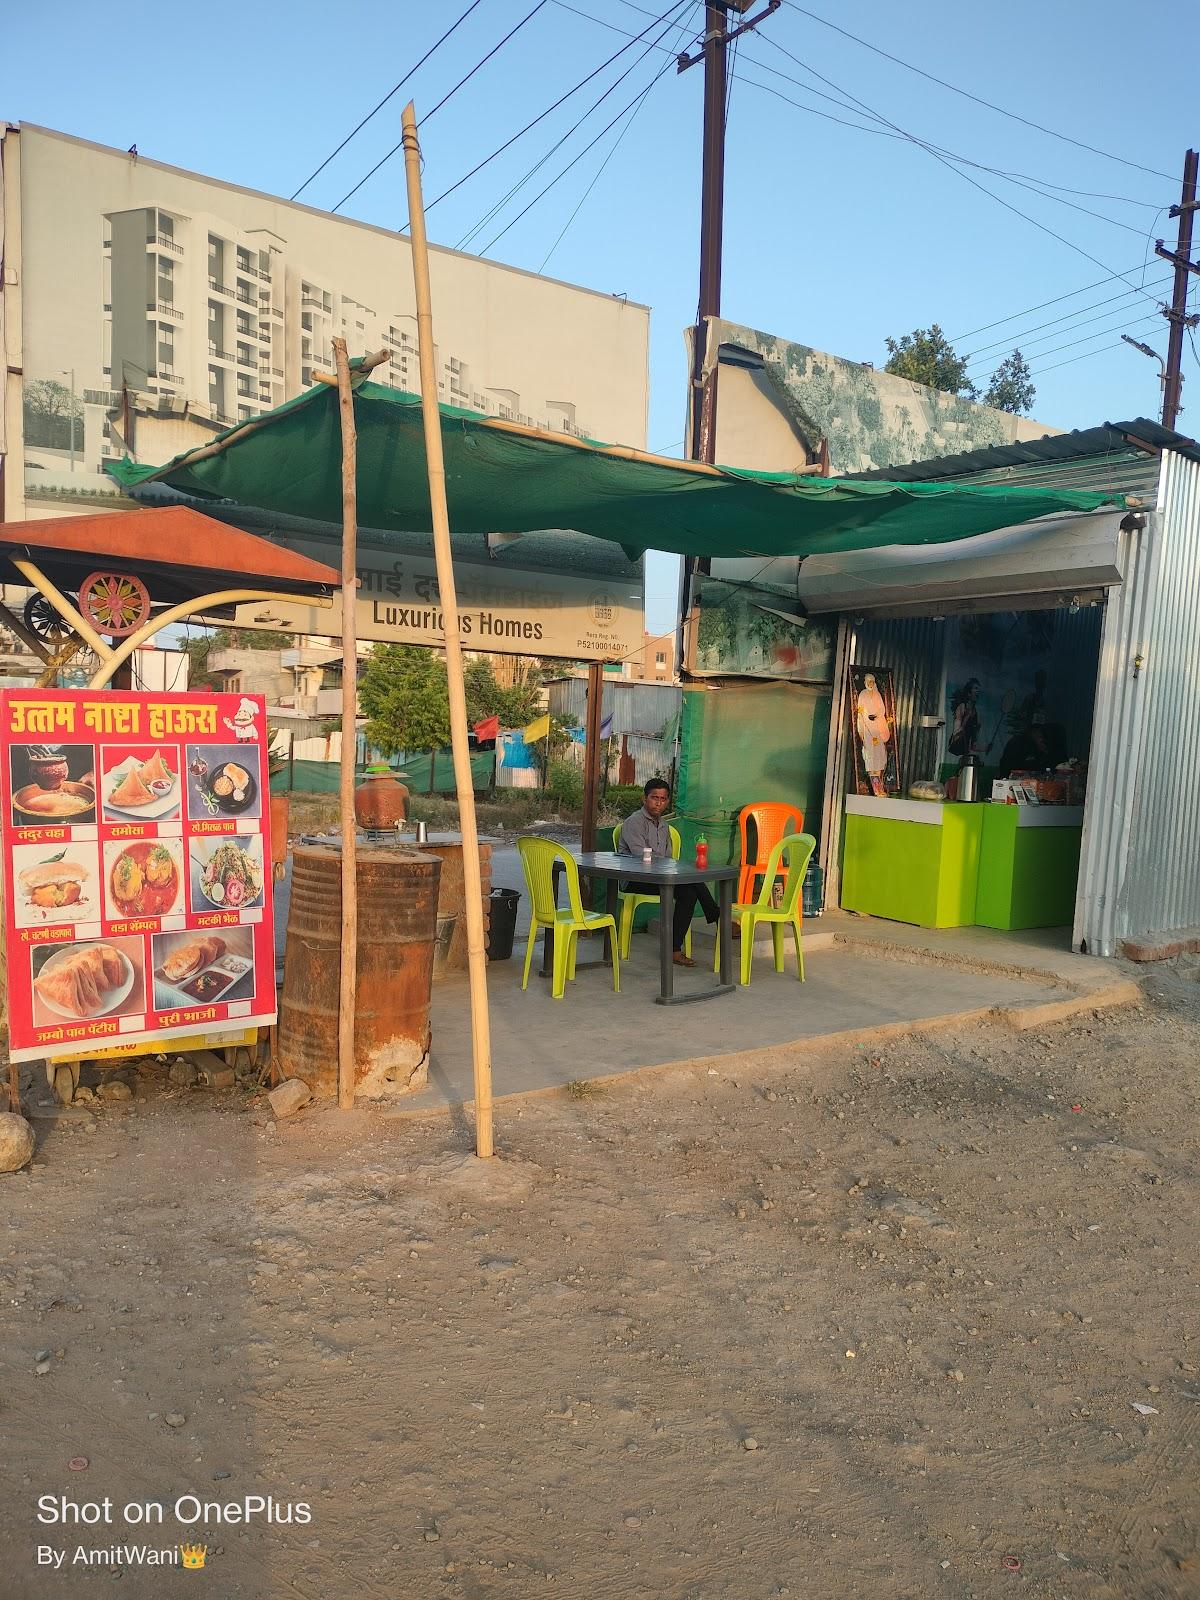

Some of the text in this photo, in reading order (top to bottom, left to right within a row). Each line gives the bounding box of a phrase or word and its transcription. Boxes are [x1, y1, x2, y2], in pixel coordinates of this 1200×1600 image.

[374, 600, 543, 640] Luxurios Homes
[577, 640, 628, 651] P52100014071
[8, 700, 218, 738] उत्तम नाष्टा हाऊस
[45, 828, 65, 838] चहा
[110, 823, 145, 836] समोसा
[197, 912, 238, 926] मटकी भेळ
[110, 923, 128, 933] वडा
[158, 1008, 217, 1028] पुरी भाजी
[36, 1027, 63, 1042] जम्बो
[66, 1028, 85, 1038] पाव
